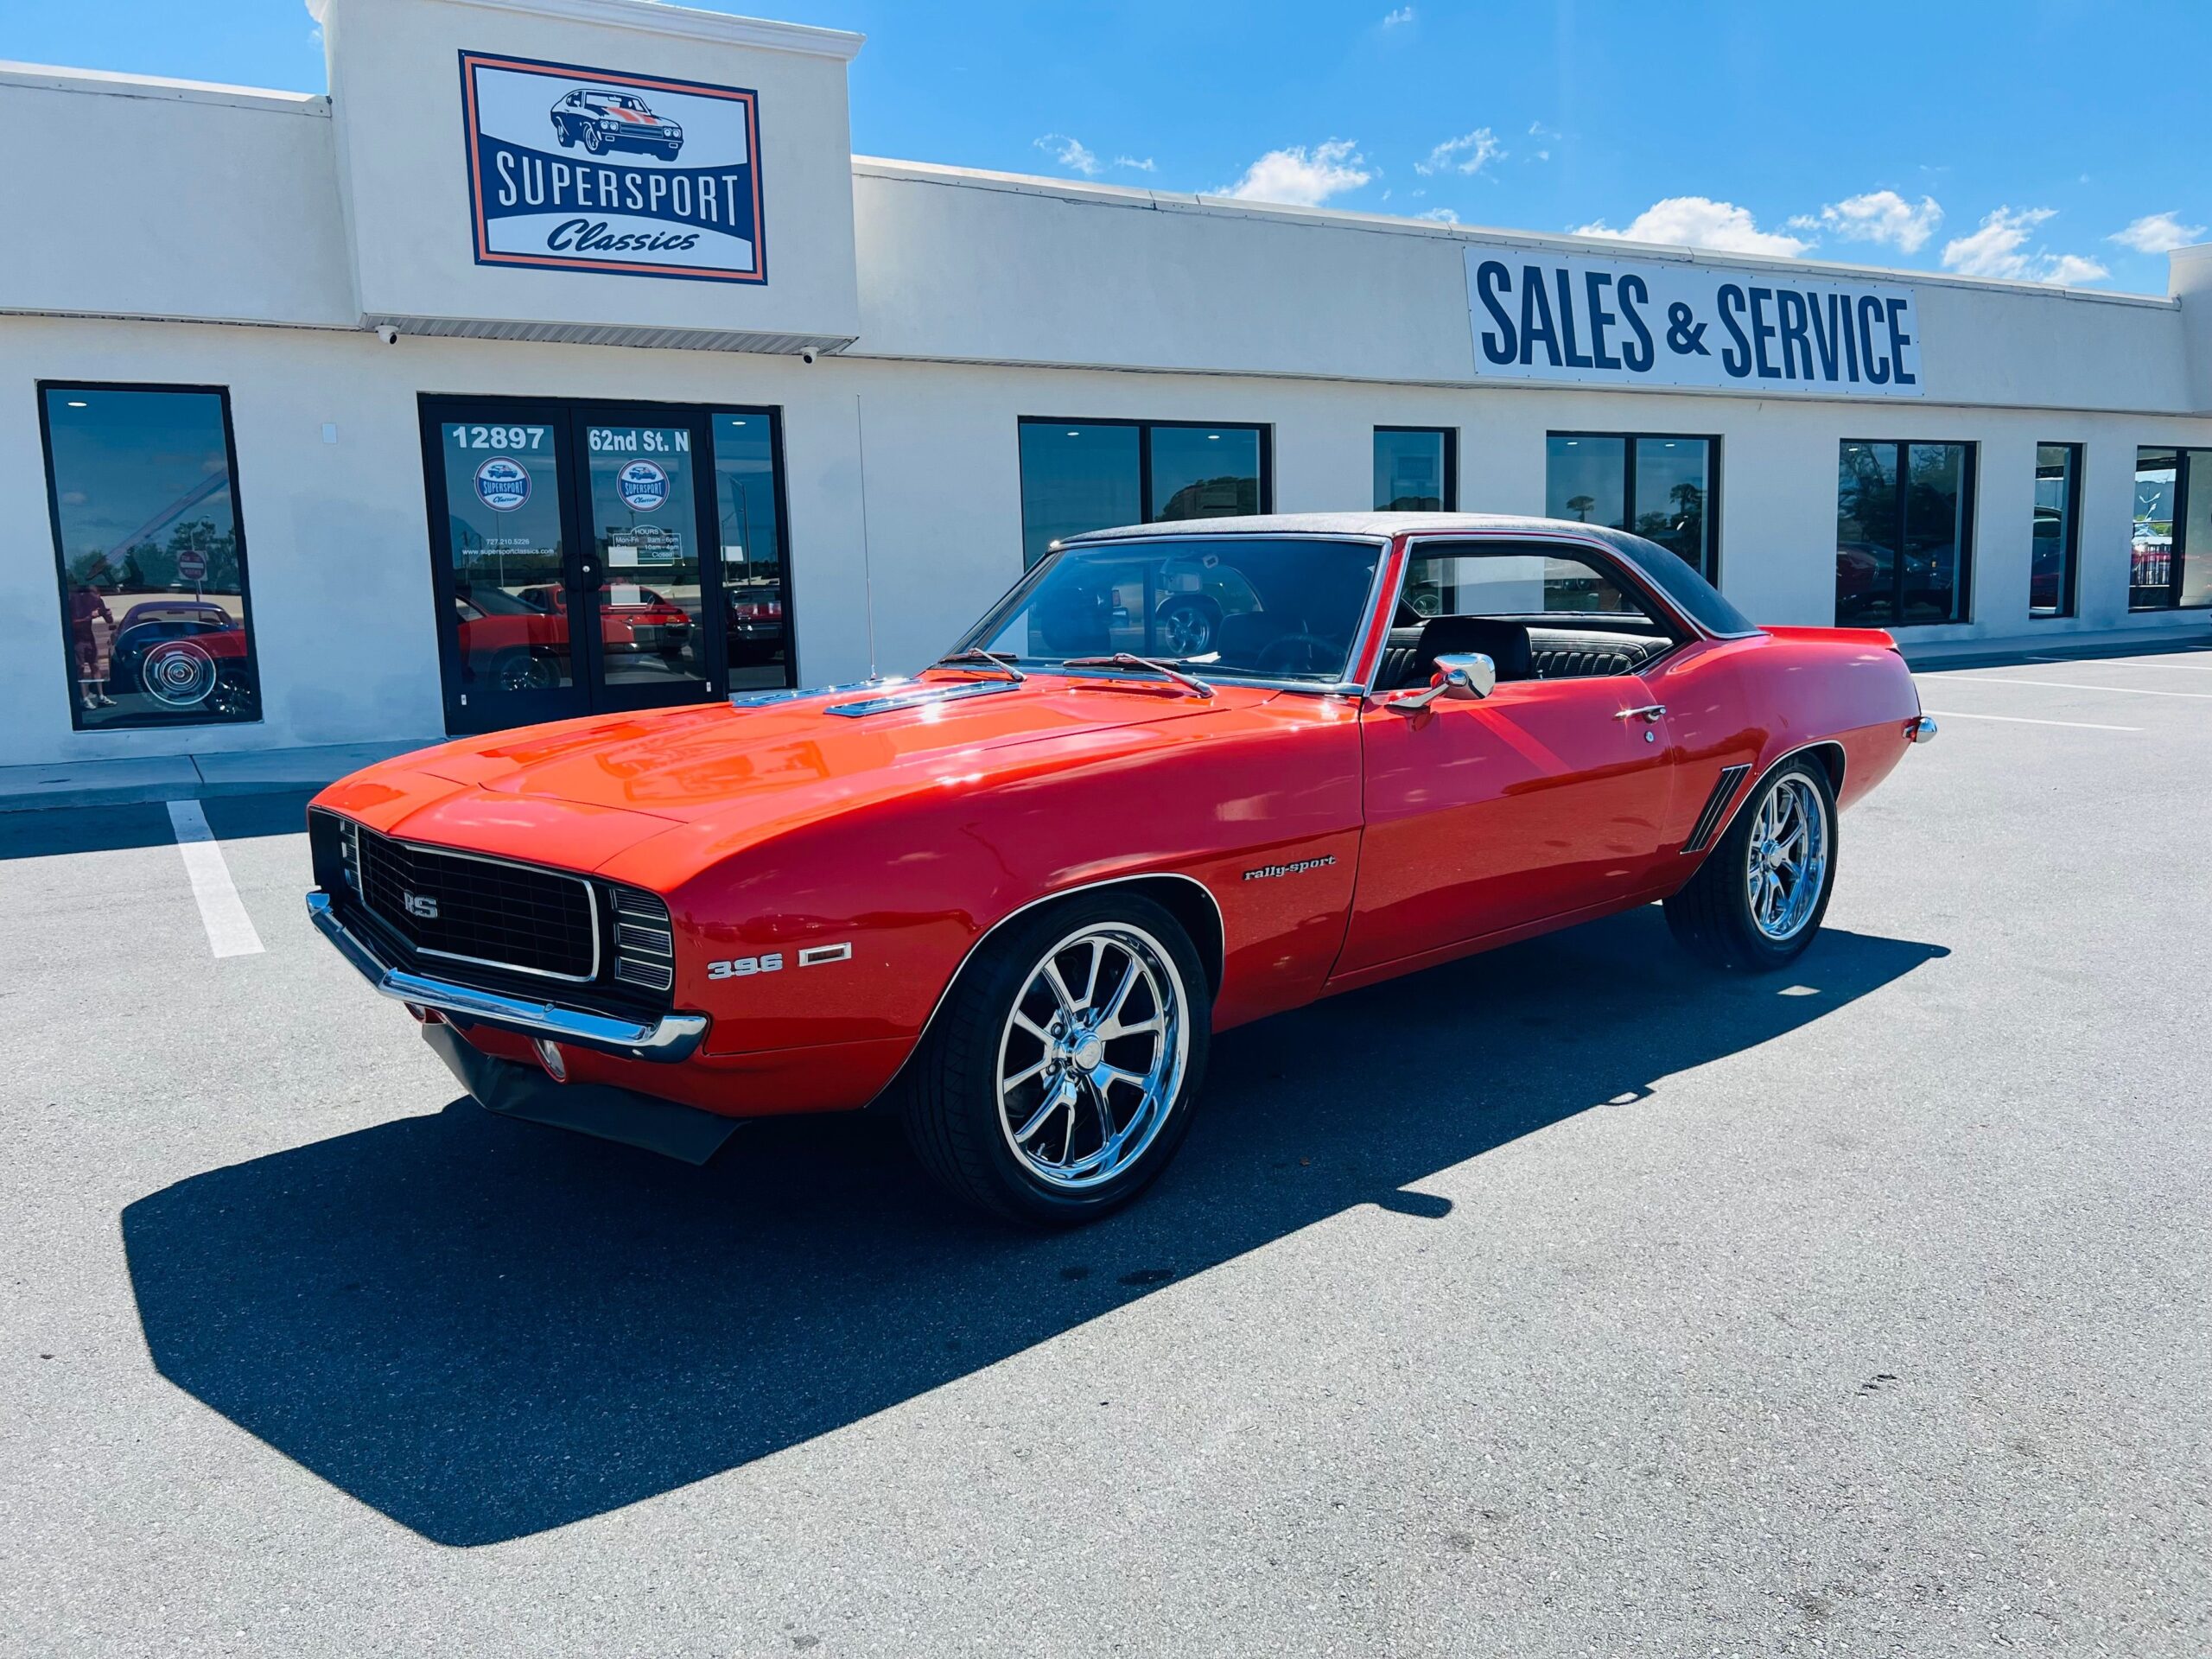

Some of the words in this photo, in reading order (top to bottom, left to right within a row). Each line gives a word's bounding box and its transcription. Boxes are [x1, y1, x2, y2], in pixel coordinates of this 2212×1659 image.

[496, 150, 738, 226] SUPERSPORT
[547, 218, 700, 252] Classics
[1477, 260, 1656, 373] SALES
[1666, 302, 1713, 356] &
[1717, 283, 1916, 385] SERVICE
[453, 426, 544, 449] 12897
[589, 429, 638, 451] 62nd
[643, 430, 670, 452] St.
[675, 431, 690, 452] N
[483, 480, 524, 495] SUPERSPORT
[625, 482, 663, 496] SUPERSPORT
[1244, 855, 1337, 880] rally-sport
[404, 889, 438, 918] RS
[707, 952, 784, 981] 396
